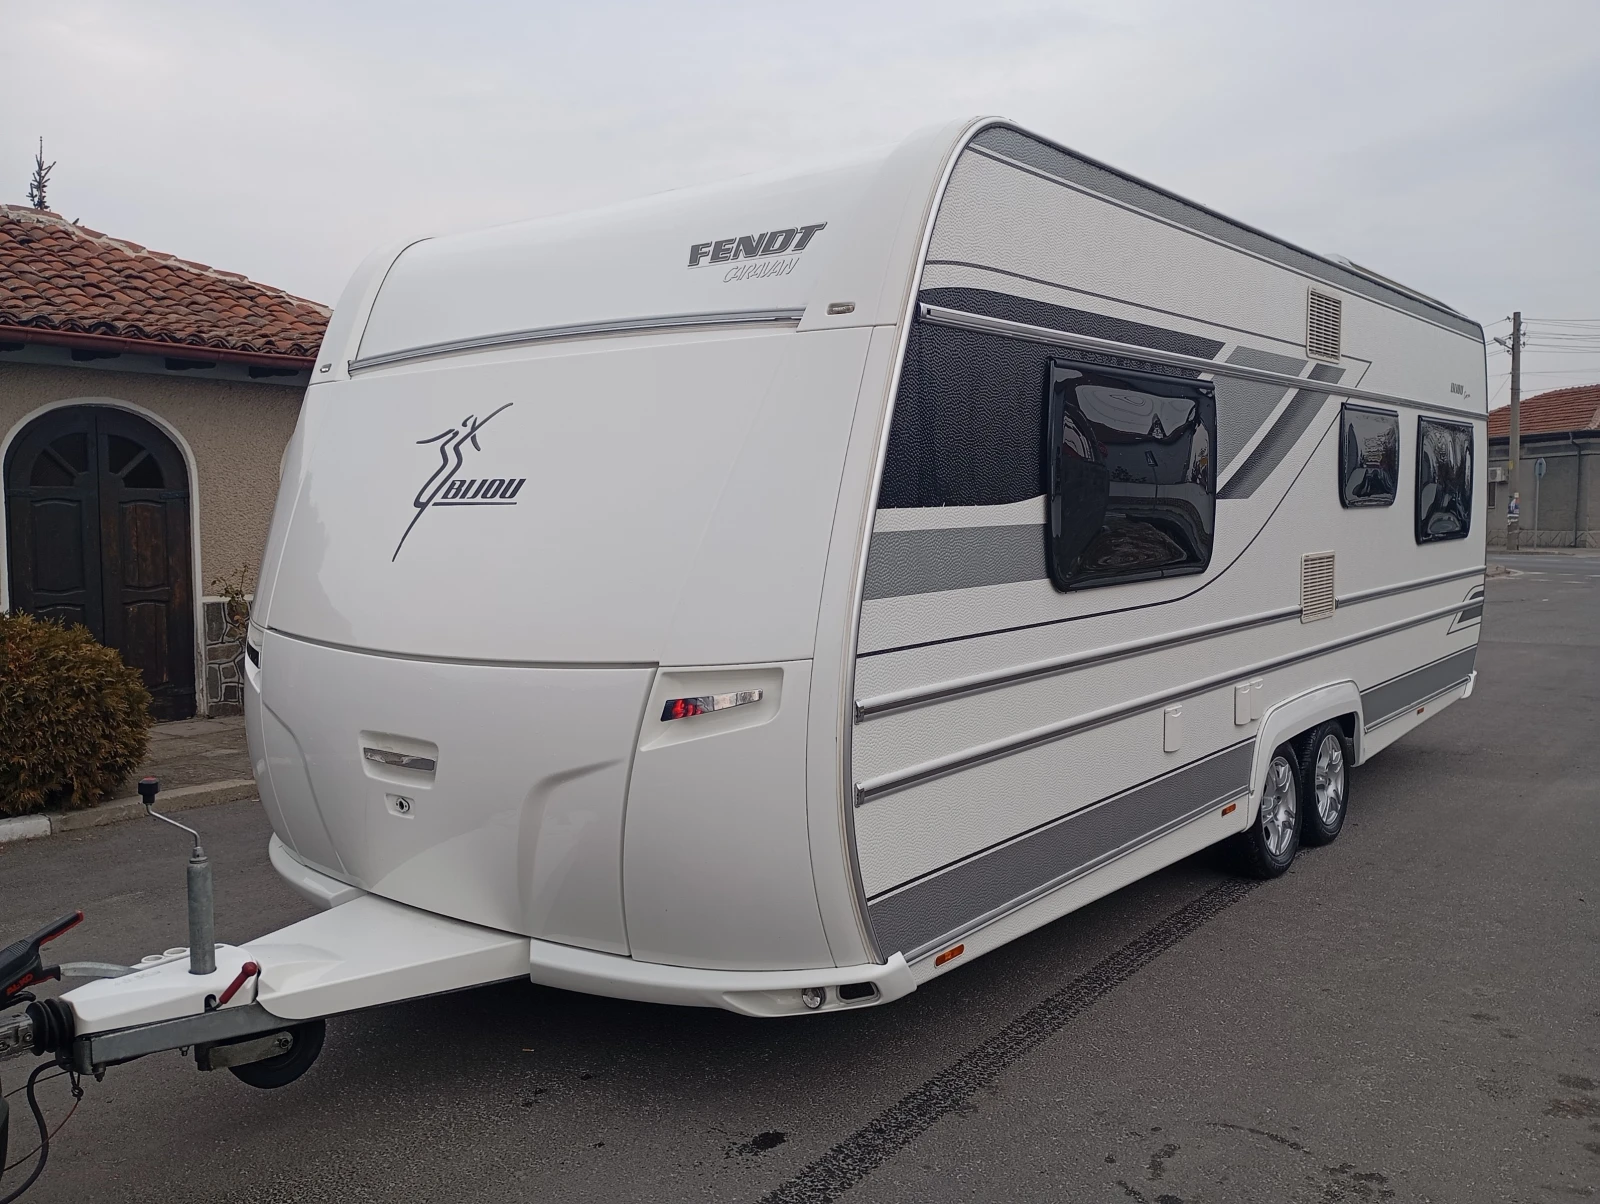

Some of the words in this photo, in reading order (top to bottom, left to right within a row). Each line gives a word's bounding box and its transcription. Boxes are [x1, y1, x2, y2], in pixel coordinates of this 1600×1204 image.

[687, 221, 828, 267] FENDT
[723, 257, 800, 283] CARAVAN
[440, 478, 527, 500] BIJOU
